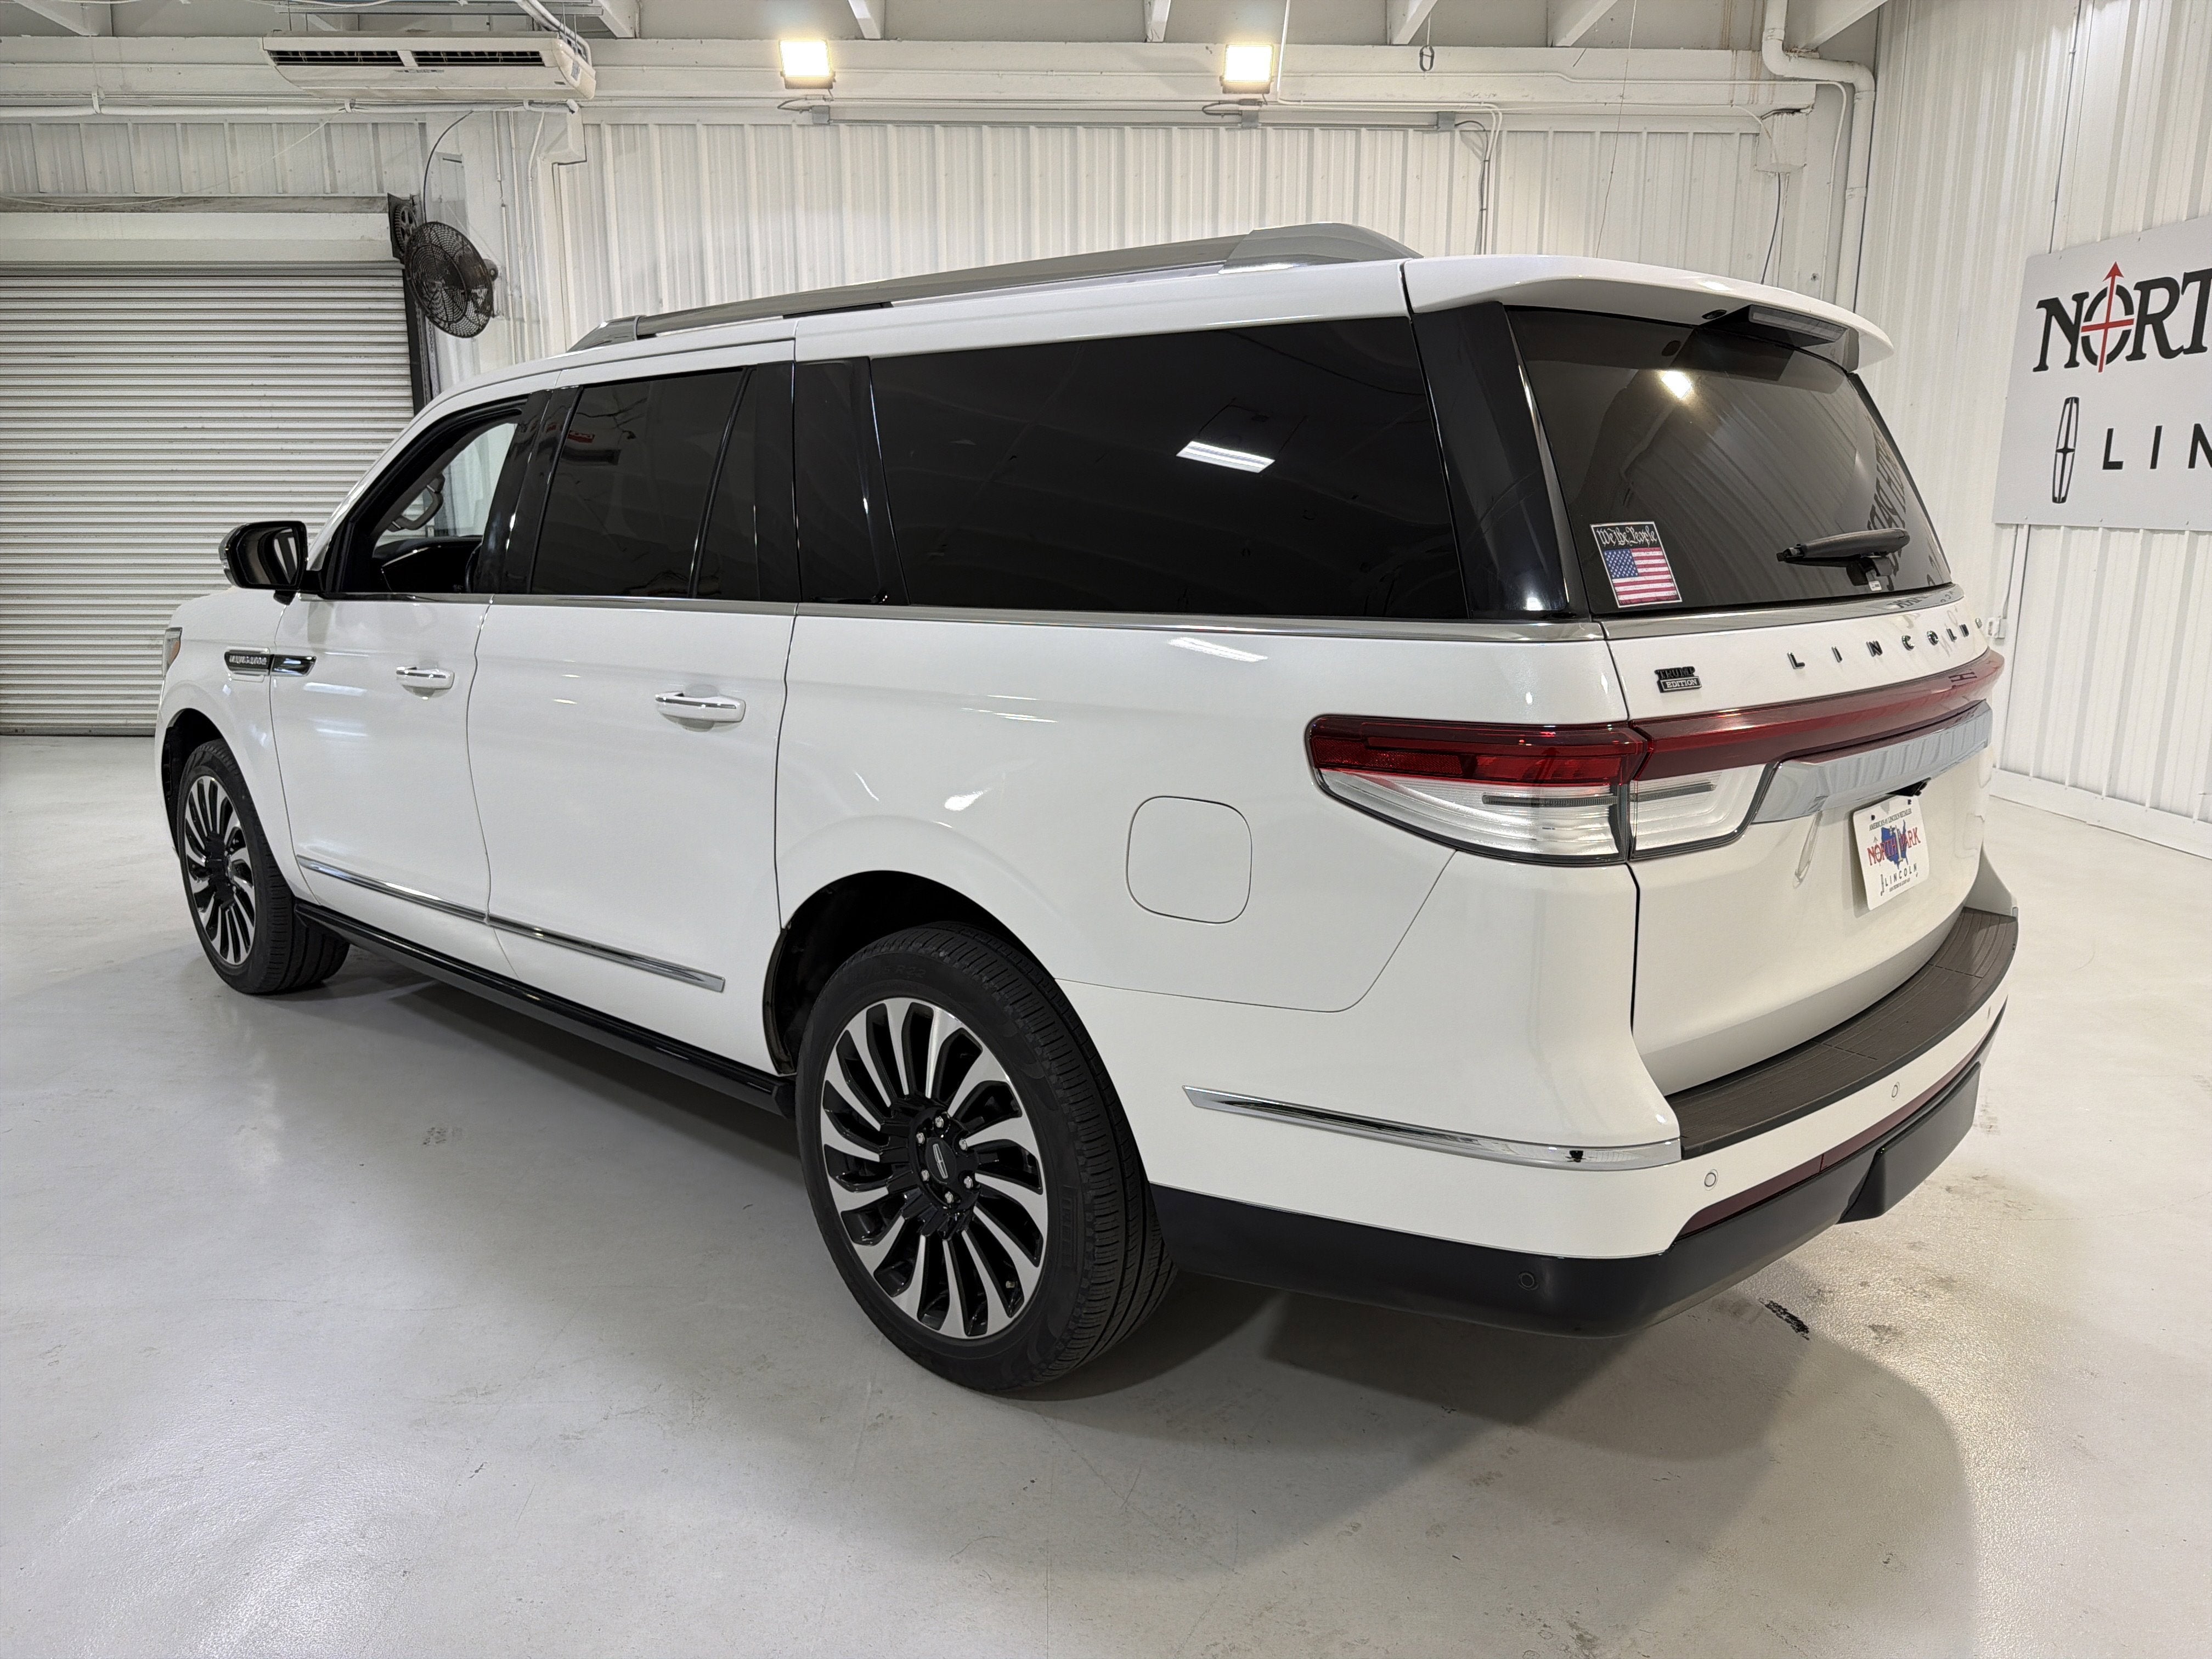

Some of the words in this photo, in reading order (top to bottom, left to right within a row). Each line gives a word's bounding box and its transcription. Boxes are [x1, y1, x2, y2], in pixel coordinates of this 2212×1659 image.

[1625, 525, 1657, 548] People
[1655, 667, 1695, 679] TRUMP
[1666, 679, 1697, 688] EDITION
[1866, 837, 1897, 866] NORTH
[1900, 827, 1921, 851] PARK
[1884, 863, 1916, 887] LINCOLN
